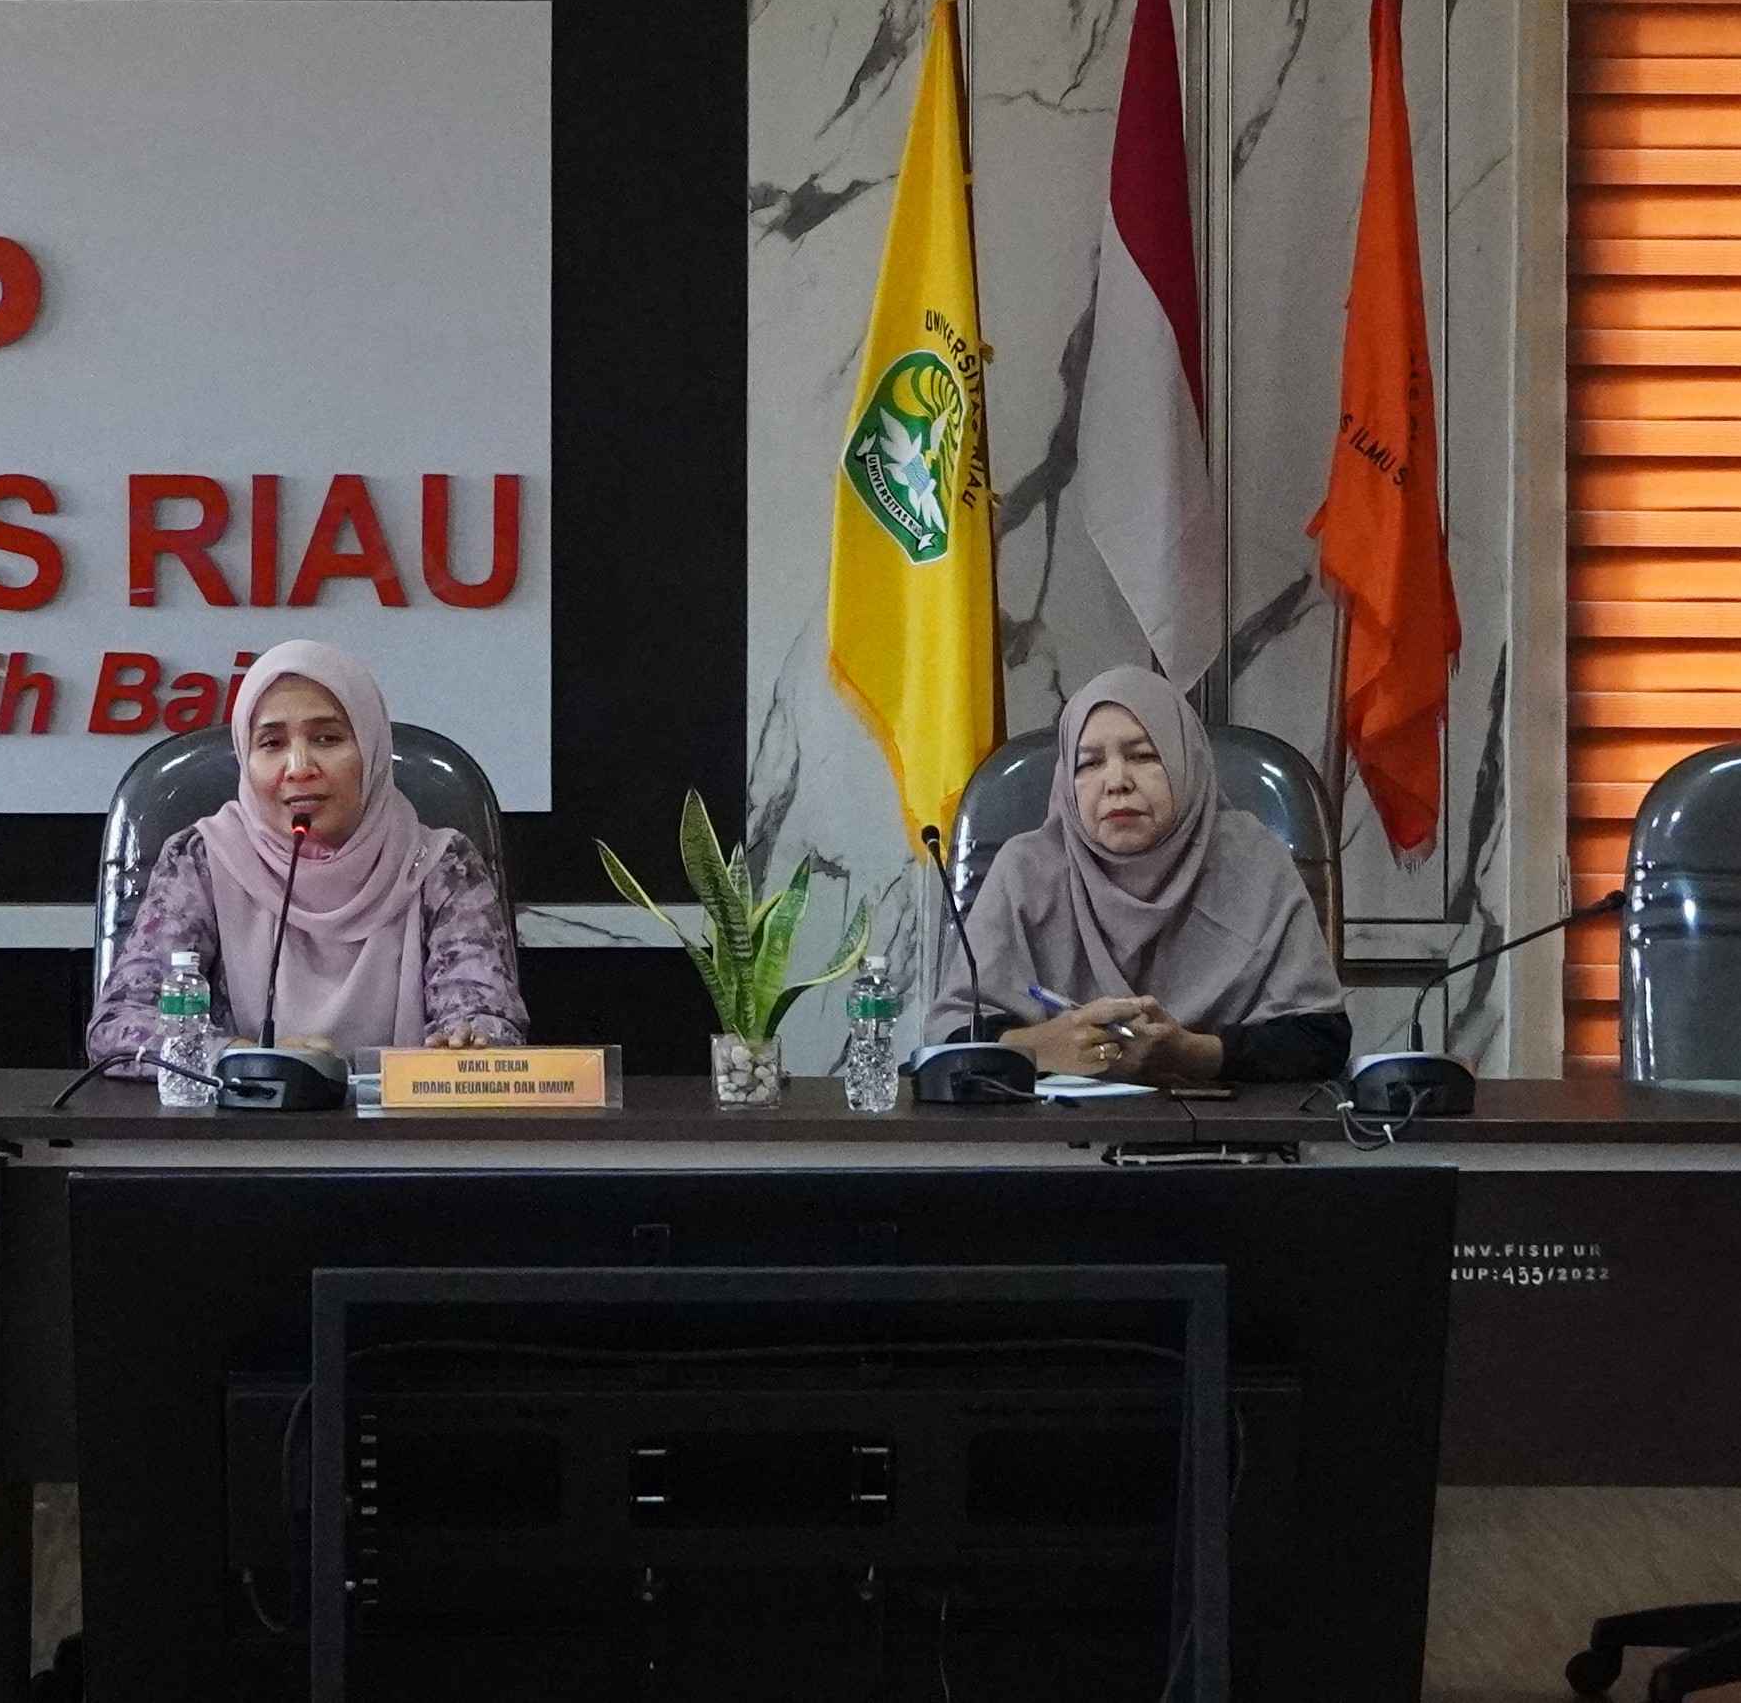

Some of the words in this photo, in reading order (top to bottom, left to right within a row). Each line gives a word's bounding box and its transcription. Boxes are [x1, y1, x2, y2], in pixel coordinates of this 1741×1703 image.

[1349, 426, 1398, 473] ILMU
[867, 456, 909, 524] UNIVERSITAS
[127, 472, 525, 611] RIAU
[88, 651, 259, 735] Bai
[412, 1081, 451, 1094] BIDANG
[455, 1081, 510, 1094] KEUANGAN
[514, 1081, 535, 1094] DAN
[538, 1081, 574, 1094] UMUM
[458, 1059, 490, 1073] WAKIL
[494, 1059, 528, 1073] DEKAN
[1453, 1245, 1564, 1258] INV.FISIP
